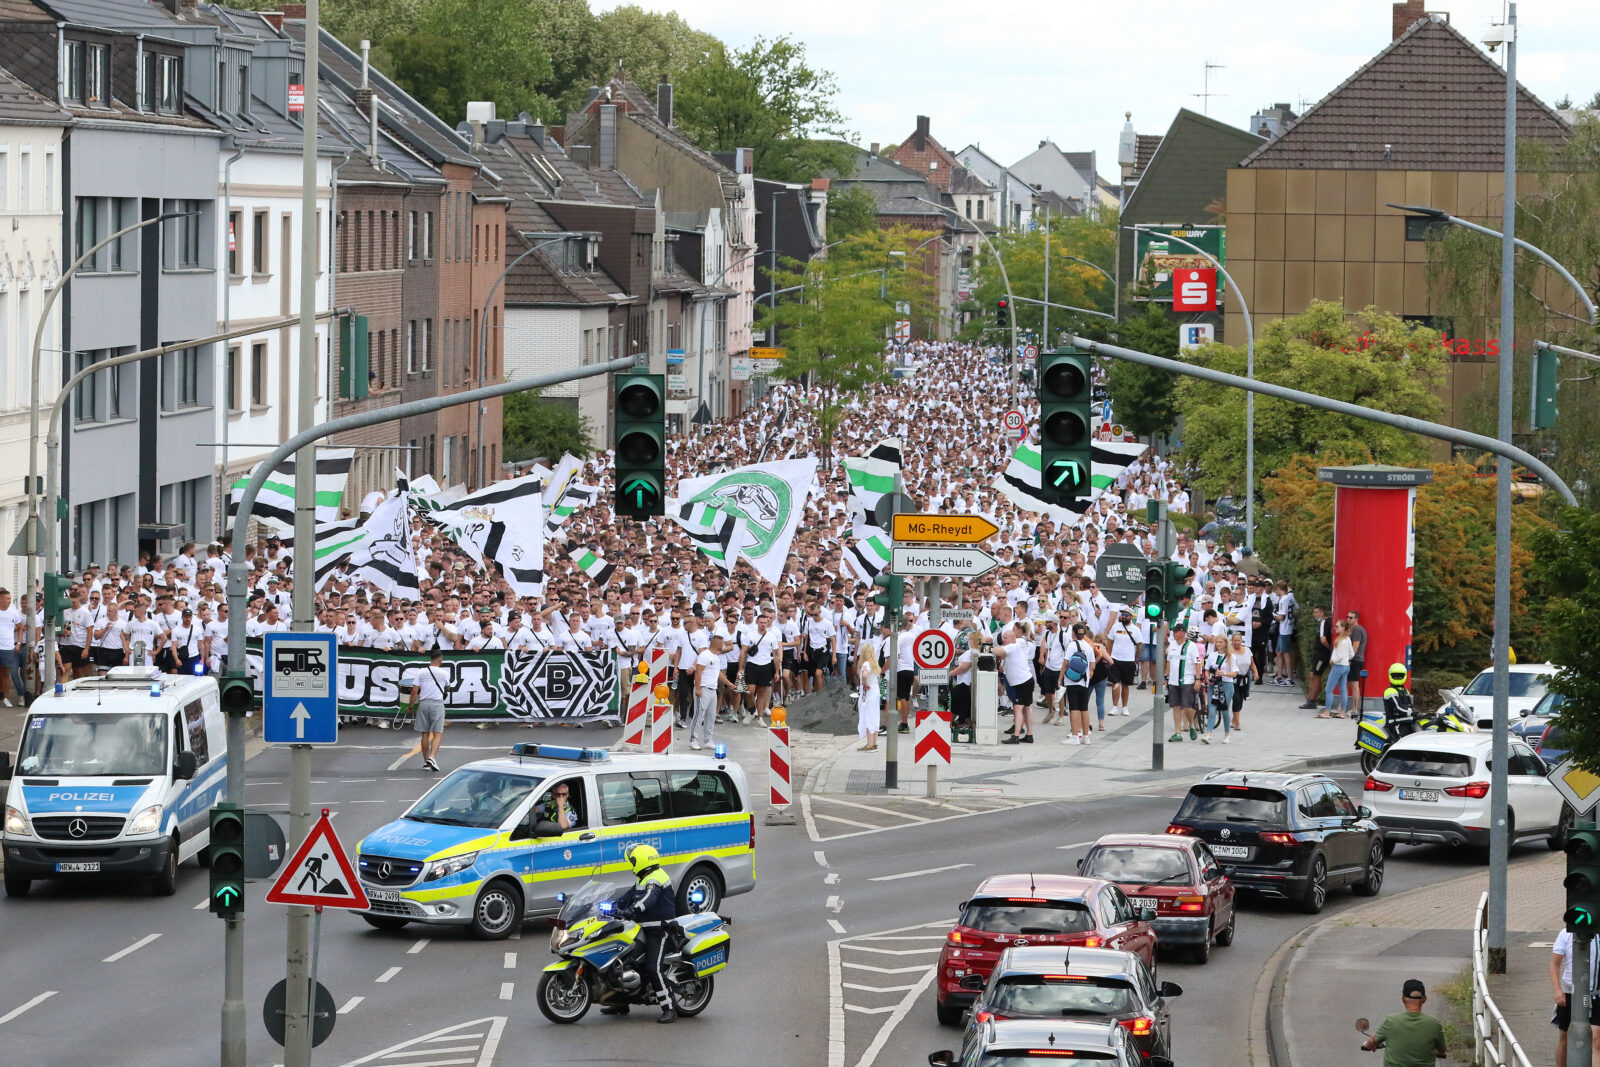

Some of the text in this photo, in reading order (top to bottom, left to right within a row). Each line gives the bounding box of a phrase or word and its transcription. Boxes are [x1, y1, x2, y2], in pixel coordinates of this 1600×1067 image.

[1171, 230, 1207, 238] SUBWAY
[1095, 389, 1108, 398] sky
[1008, 415, 1021, 426] 30
[1100, 431, 1112, 442] STOP
[1387, 473, 1415, 482] STRÖER
[908, 523, 972, 535] MG-Rheydt
[906, 556, 973, 568] Hochschule
[942, 610, 972, 619] Bahnstraße
[921, 640, 946, 660] 30
[1362, 735, 1382, 749] POLIZEI
[49, 792, 115, 801] POLIZEI
[1231, 847, 1247, 855] 1004
[59, 863, 73, 871] NRW
[83, 863, 100, 871] 2121
[1139, 899, 1157, 908] 2039
[696, 952, 723, 970] POLIZEI
